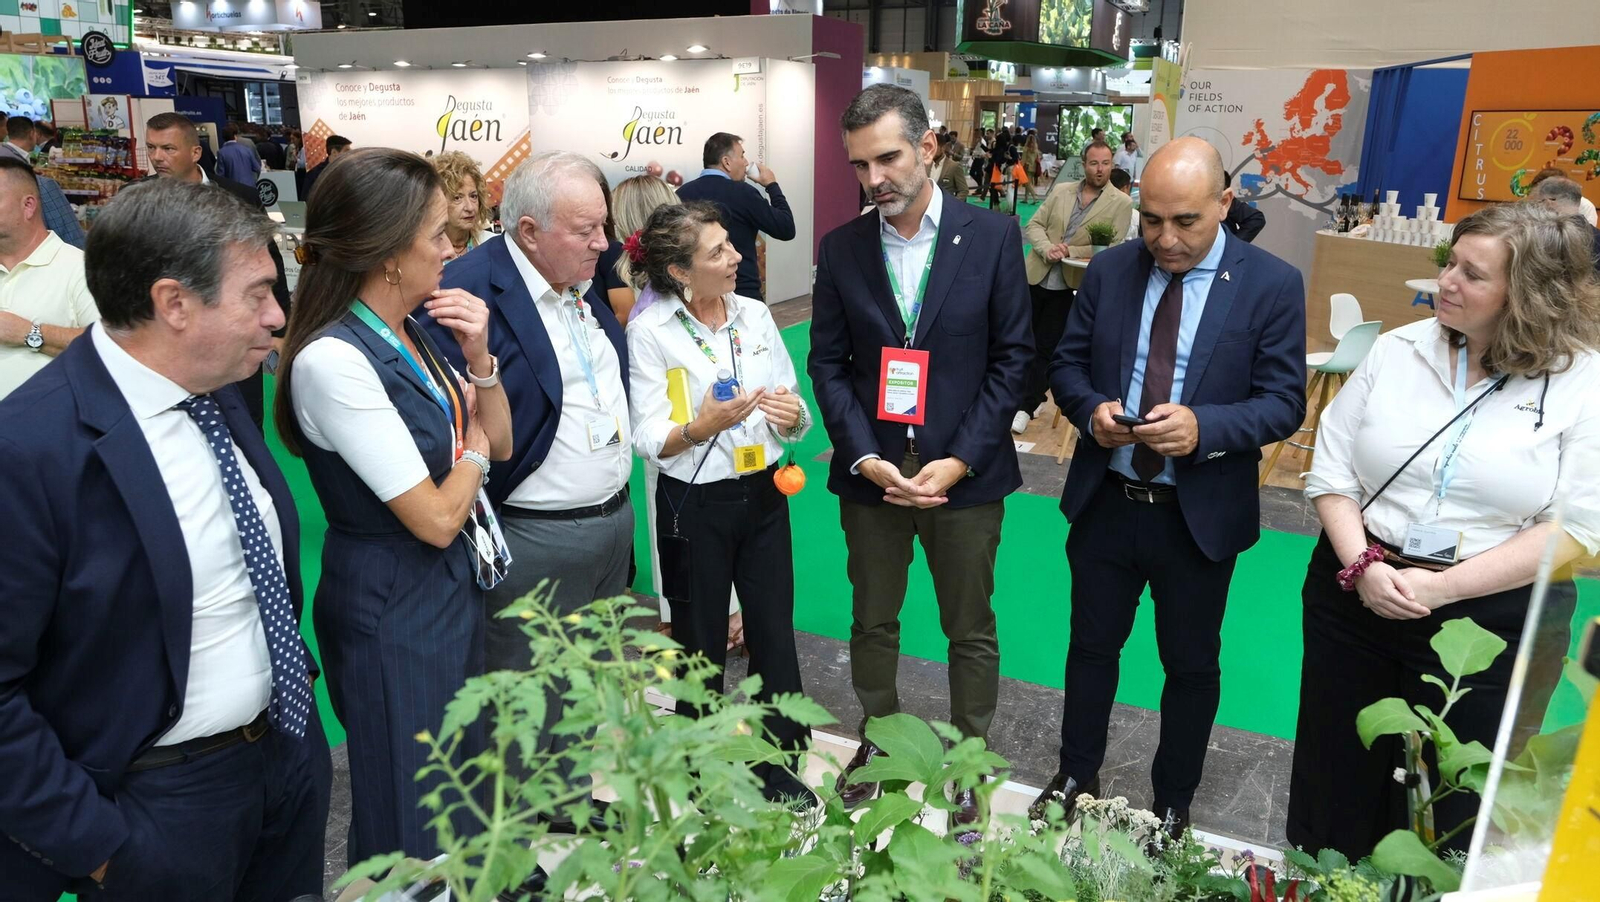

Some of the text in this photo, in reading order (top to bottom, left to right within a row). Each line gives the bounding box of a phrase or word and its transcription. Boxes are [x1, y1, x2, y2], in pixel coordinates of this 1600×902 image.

[636, 76, 663, 85] Degusta
[1190, 81, 1211, 90] OUR
[335, 82, 362, 93] Conoce
[369, 82, 401, 93] Degusta
[684, 86, 700, 94] Jaén
[1189, 93, 1223, 101] FIELDS
[444, 94, 493, 114] Degusta
[1188, 104, 1243, 113] OF ACTION
[338, 111, 366, 121] de Jaén
[631, 105, 675, 122] Degusta
[1506, 129, 1519, 139] 22
[1504, 140, 1523, 150] 000
[1473, 114, 1486, 200] CITRUS
[625, 165, 653, 173] CALIDAD
